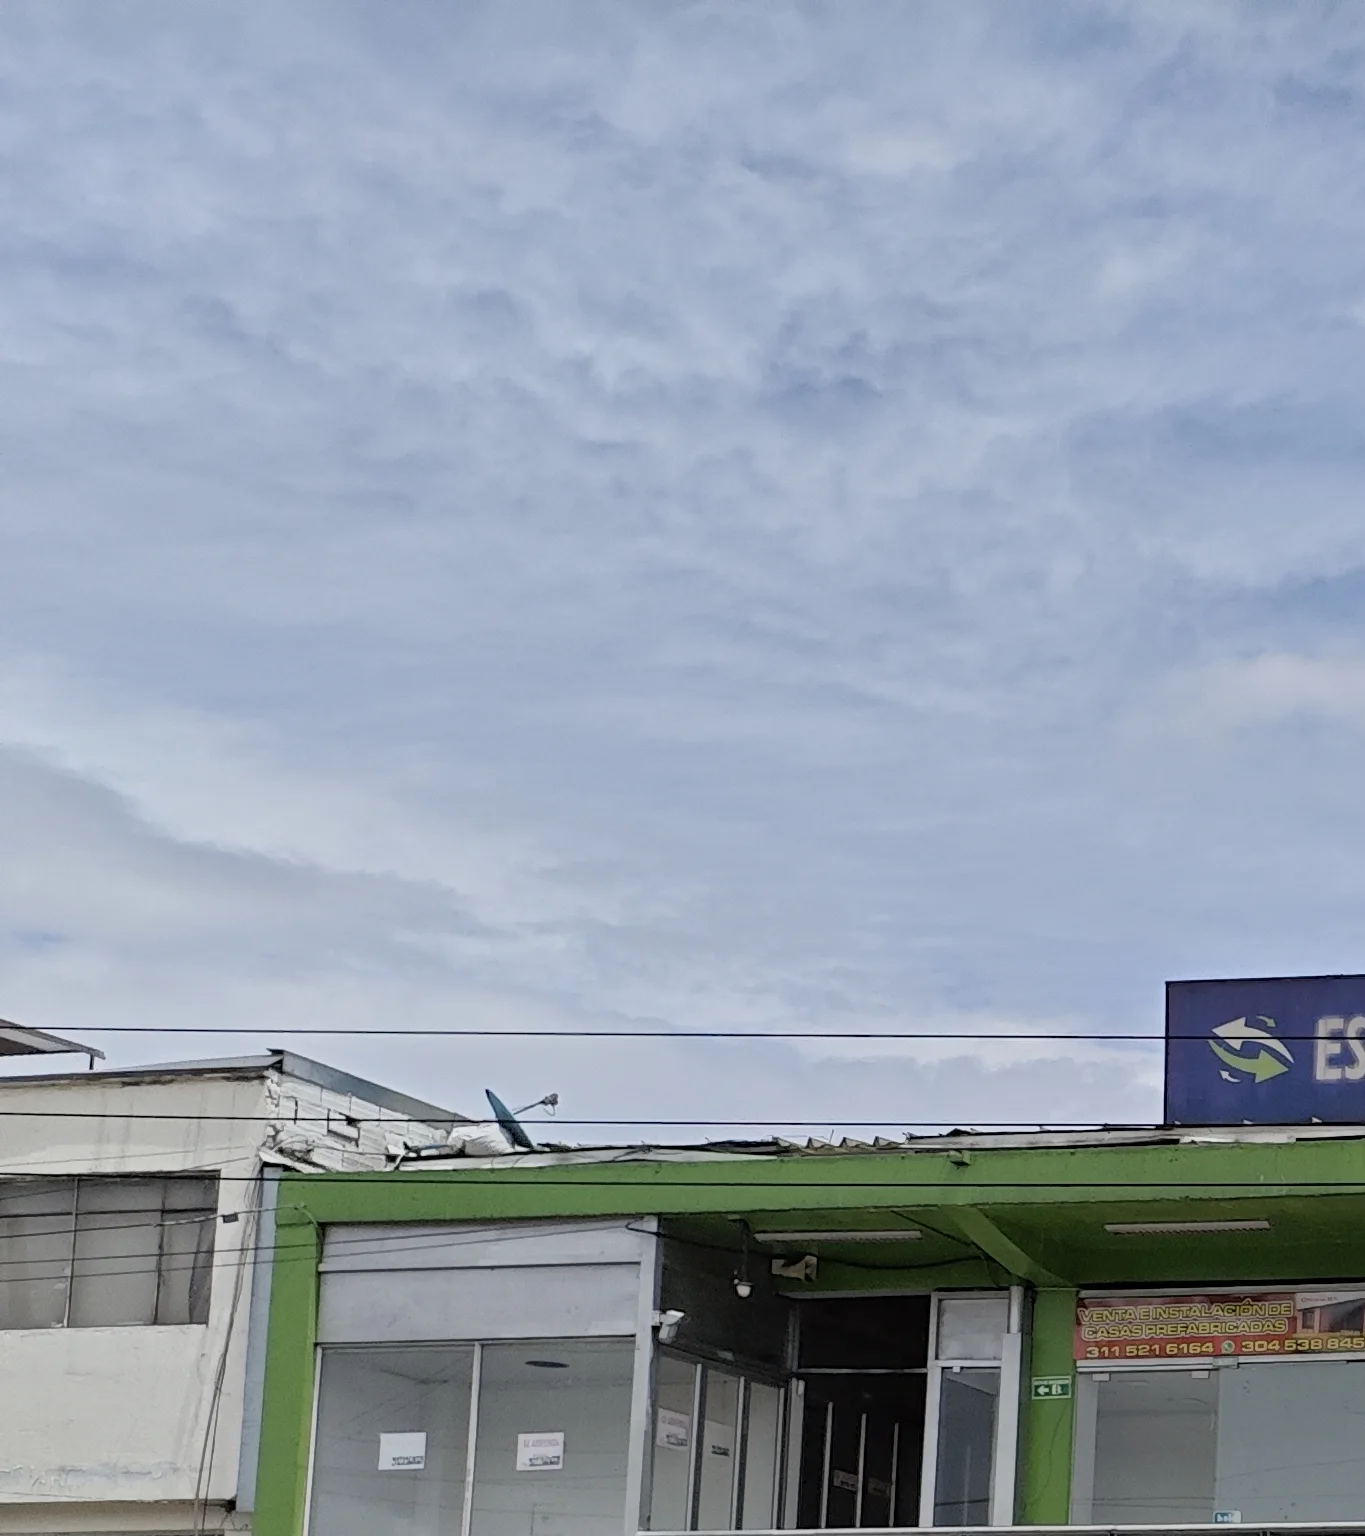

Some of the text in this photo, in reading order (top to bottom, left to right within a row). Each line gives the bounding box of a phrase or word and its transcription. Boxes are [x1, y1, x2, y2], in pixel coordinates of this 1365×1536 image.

[1078, 1300, 1293, 1323] VENTA E INSTALACIÓN DE
[1083, 1319, 1288, 1340] CASAS PREFABRICADAS
[1086, 1346, 1120, 1358] 311
[1126, 1345, 1160, 1357] 521
[1166, 1342, 1214, 1355] 6164
[1241, 1340, 1280, 1353] 304
[1284, 1338, 1323, 1351] 538
